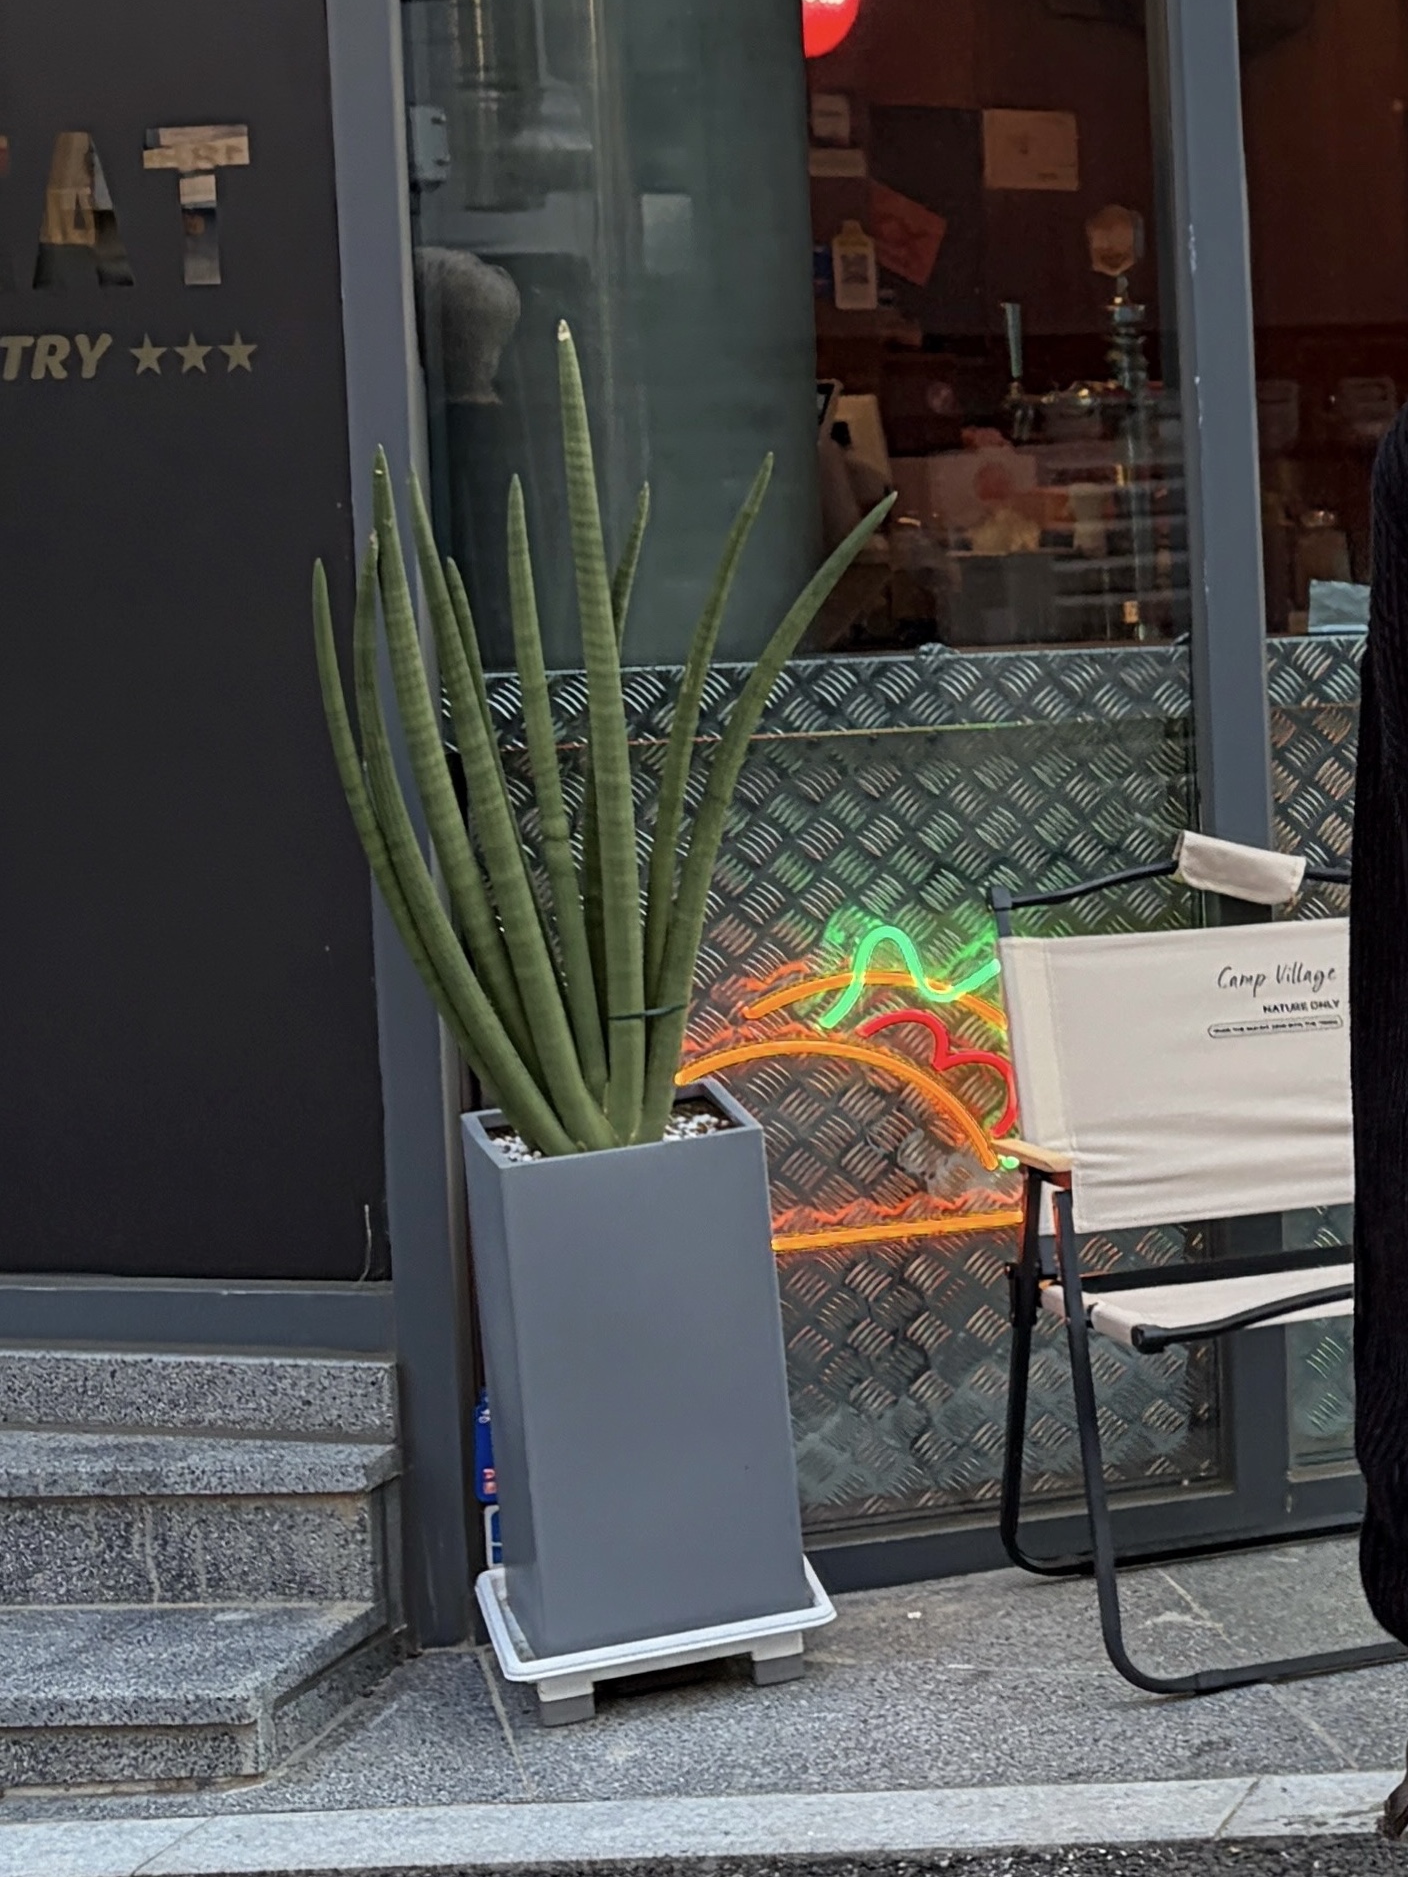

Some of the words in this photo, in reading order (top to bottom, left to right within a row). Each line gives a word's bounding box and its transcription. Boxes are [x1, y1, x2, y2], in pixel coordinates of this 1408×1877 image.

[0, 124, 251, 291] AT
[0, 332, 114, 382] TRY
[1216, 965, 1267, 999] Camp
[1275, 960, 1338, 994] Village
[1262, 1001, 1309, 1015] NATURE
[1309, 998, 1341, 1011] ONLY
